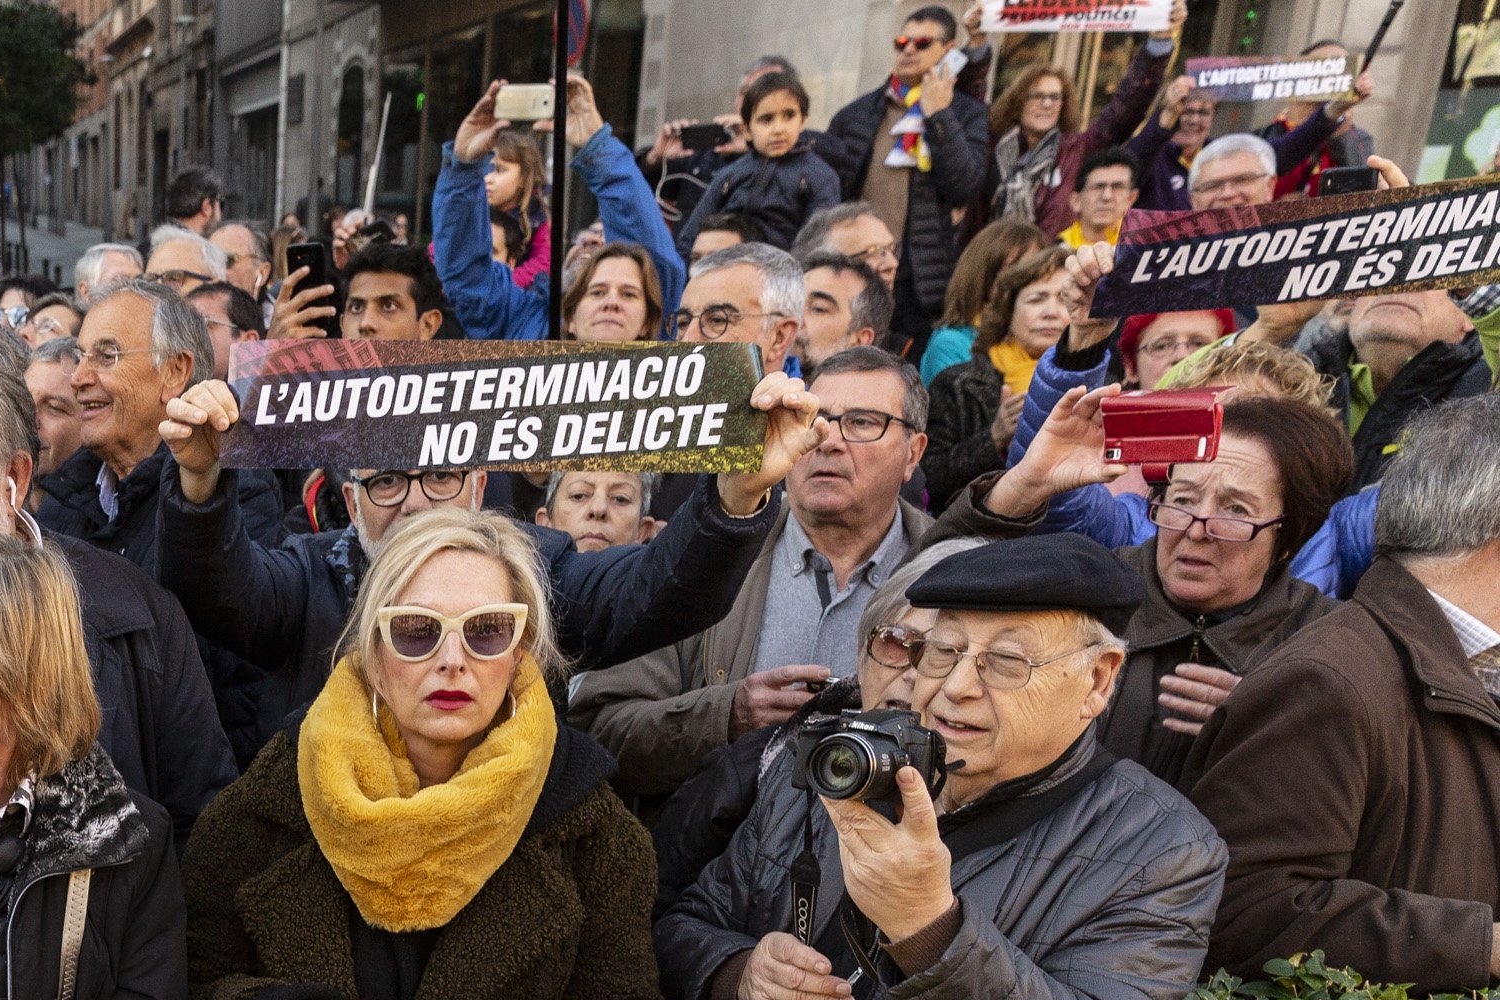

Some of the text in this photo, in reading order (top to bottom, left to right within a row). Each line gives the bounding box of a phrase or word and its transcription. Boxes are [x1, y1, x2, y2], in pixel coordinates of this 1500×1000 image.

[1251, 81, 1274, 101] NO
[1130, 189, 1500, 283] L'AUTODETERMINA
[1277, 231, 1500, 301] NO ÉS DELI
[255, 346, 706, 425] L'AUTODETERMINACIÓ
[418, 402, 729, 467] NO ÉS DELICTE
[851, 721, 875, 731] Nikon
